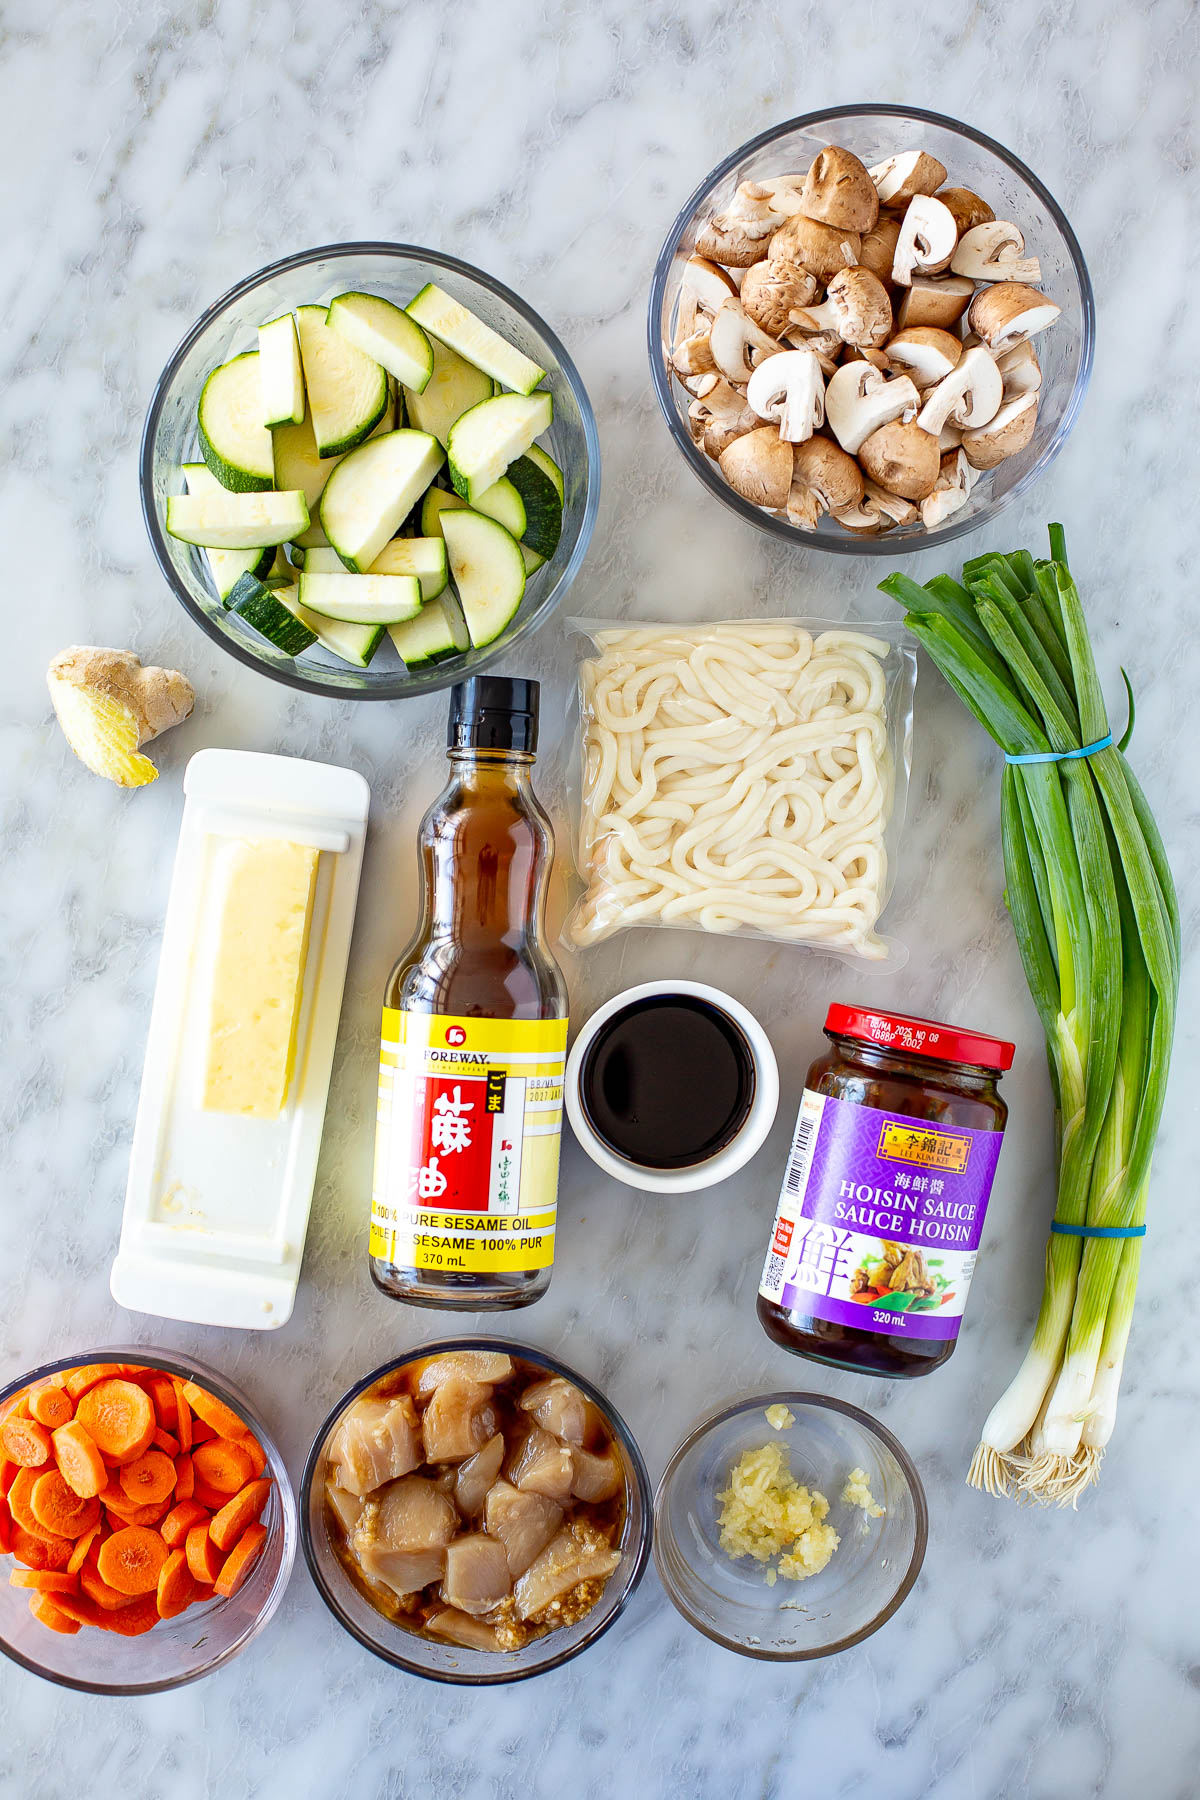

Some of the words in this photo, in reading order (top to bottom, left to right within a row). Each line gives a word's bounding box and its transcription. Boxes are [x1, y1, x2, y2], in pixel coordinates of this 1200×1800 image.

[895, 1025, 913, 1038] 2025
[916, 1030, 926, 1040] NO
[928, 1032, 940, 1043] 08
[900, 1037, 923, 1050] 2002
[487, 1073, 506, 1111] ごま
[530, 1091, 548, 1102] 2027
[904, 1133, 953, 1156] 李錦記
[900, 1149, 913, 1158] LEE
[916, 1152, 934, 1162] KUM
[839, 1179, 919, 1213] HOISIN
[923, 1199, 977, 1221] SAUCE
[376, 1206, 399, 1221] 100%
[403, 1212, 439, 1228] PURE
[444, 1216, 507, 1231] SESAME
[512, 1218, 532, 1230] OIL
[834, 1202, 904, 1233] SAUCE
[908, 1218, 972, 1242] HOISIN
[412, 1232, 475, 1250] SÉSAME
[481, 1238, 516, 1251] 100%
[520, 1236, 542, 1249] PUR
[423, 1253, 443, 1265] 370
[447, 1254, 466, 1267] mL
[791, 1221, 853, 1297] 鮮
[872, 1310, 891, 1325] 320
[891, 1315, 907, 1327] mL
